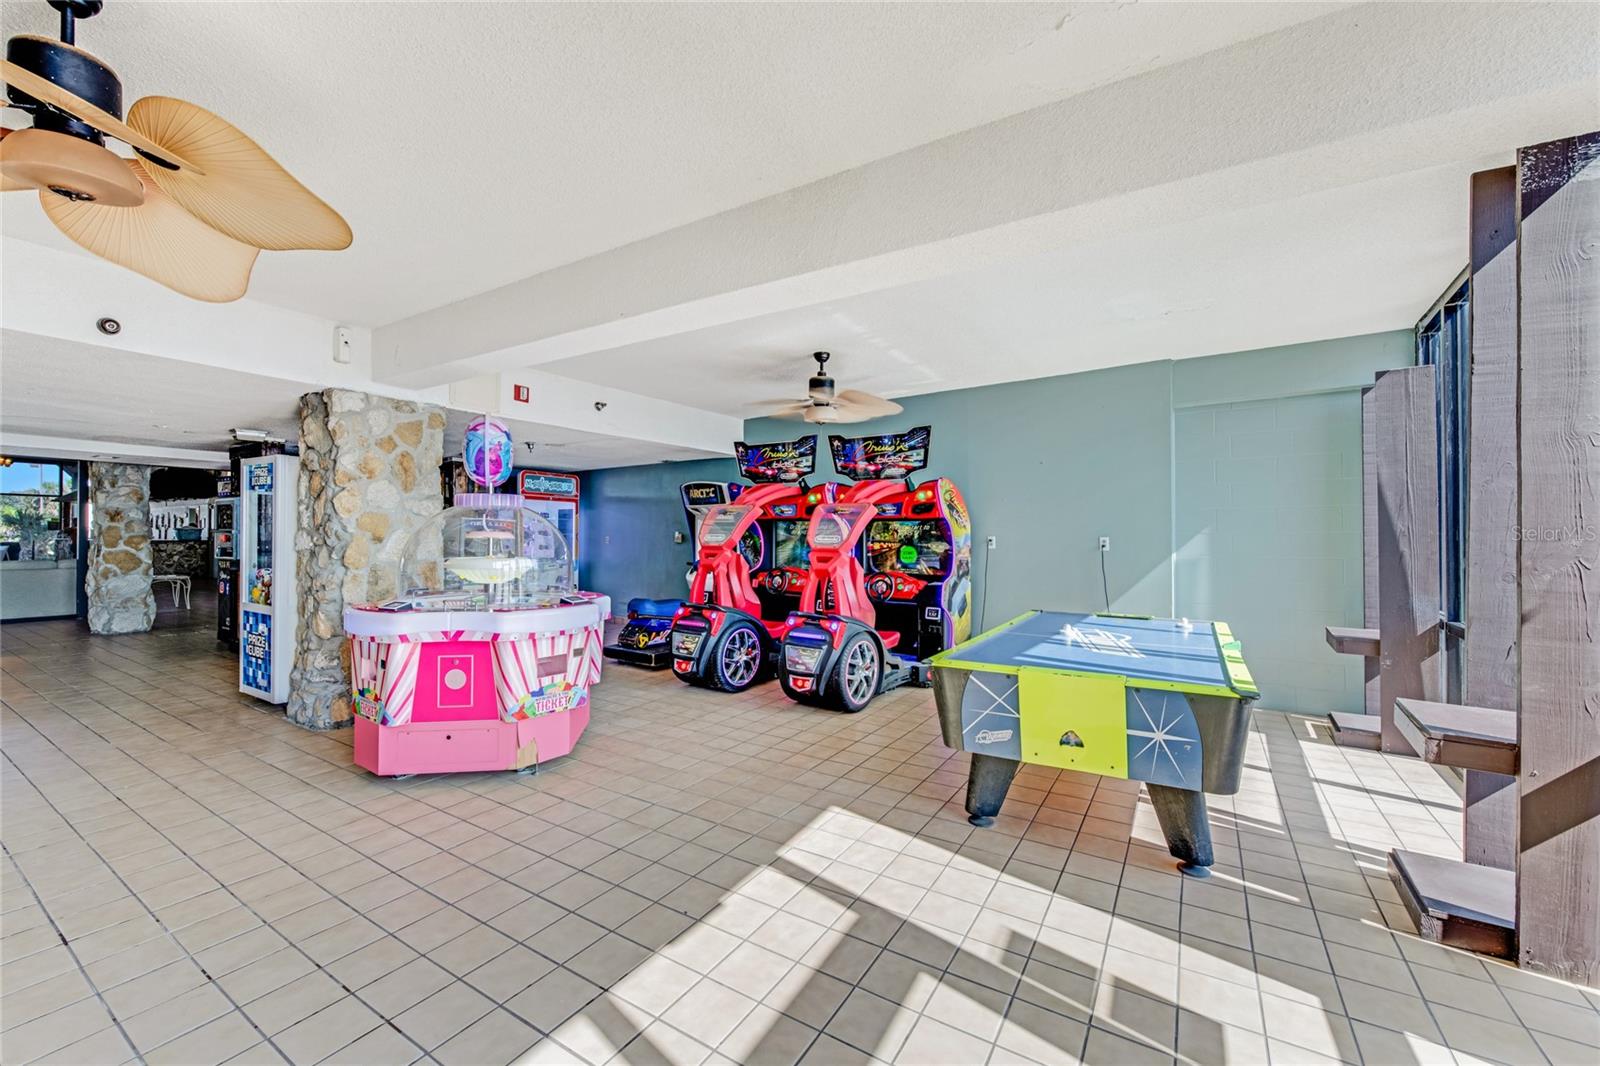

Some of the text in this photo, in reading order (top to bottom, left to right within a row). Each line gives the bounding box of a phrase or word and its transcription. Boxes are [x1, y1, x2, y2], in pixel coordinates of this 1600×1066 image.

[248, 633, 266, 648] PRIZE
[248, 644, 265, 659] CUBE
[536, 695, 570, 713] TICKET
